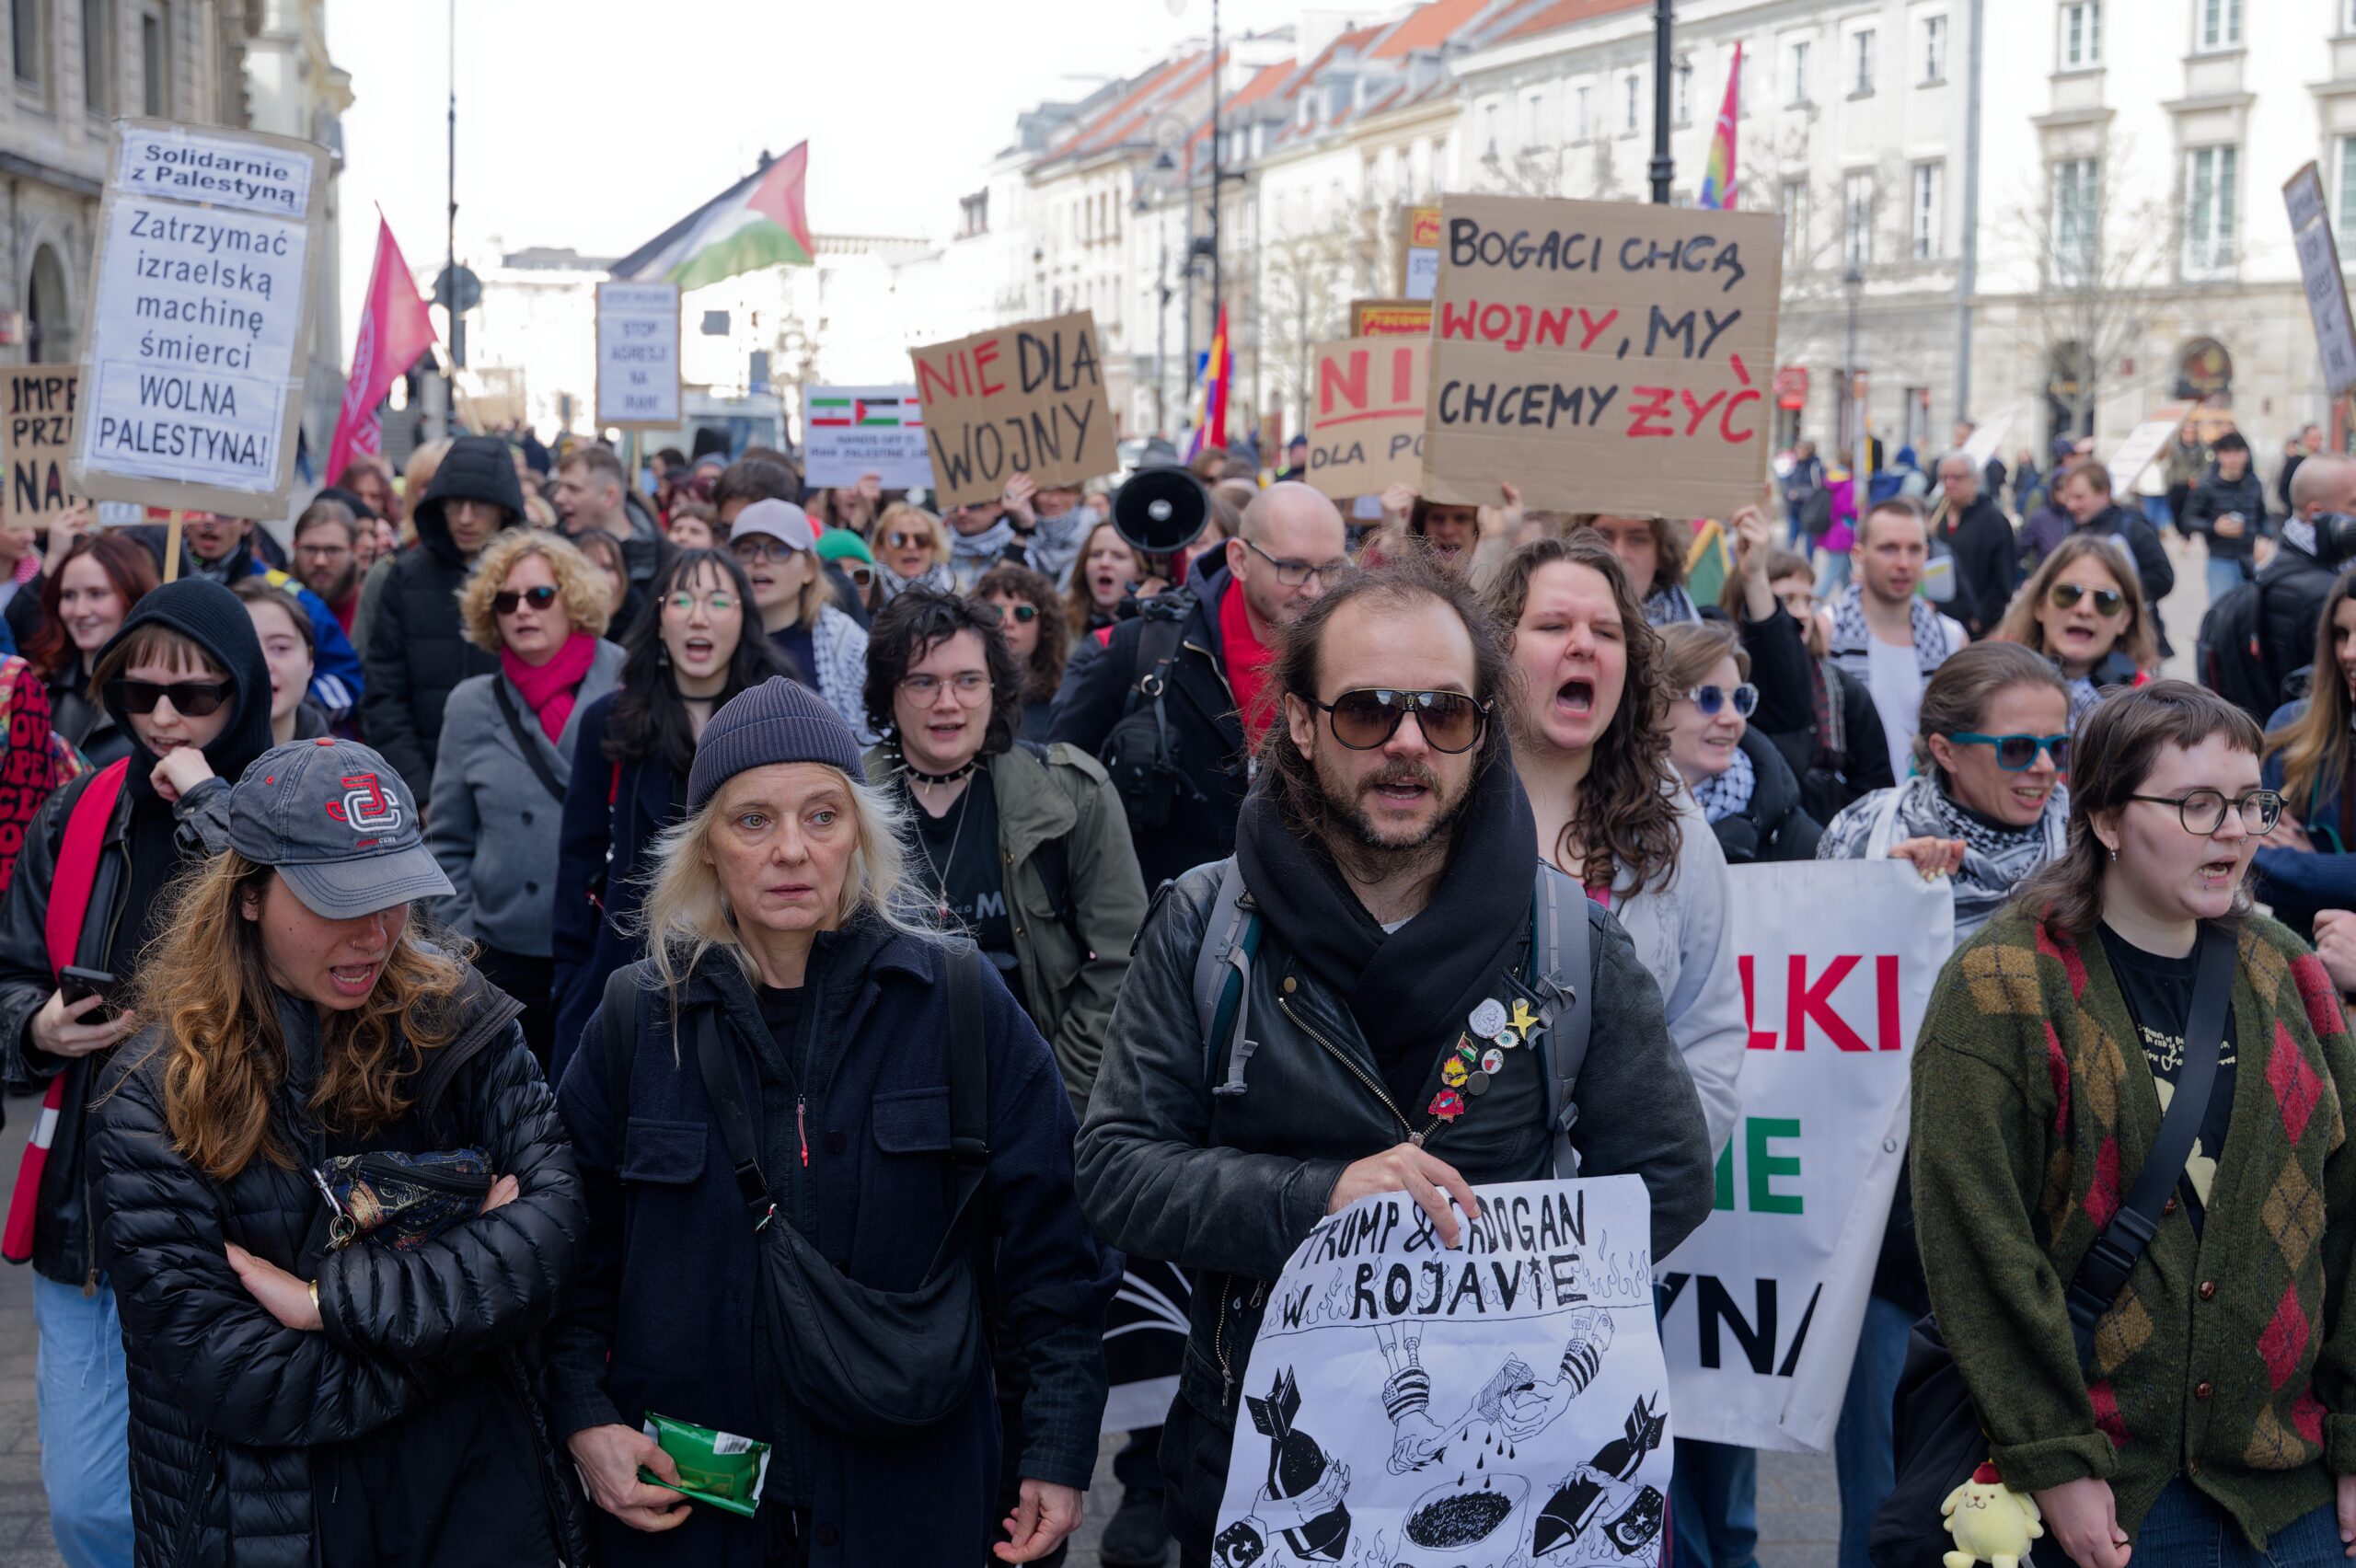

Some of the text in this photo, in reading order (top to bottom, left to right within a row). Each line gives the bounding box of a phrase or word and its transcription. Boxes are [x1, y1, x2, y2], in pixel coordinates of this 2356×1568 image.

[145, 144, 289, 181] Solidarnie
[132, 166, 296, 209] z Palestyną
[130, 210, 288, 257] Zatrzymać
[1449, 220, 1744, 292] BOGACI CHCĄ
[137, 249, 272, 302] izraelską
[136, 294, 264, 339] machinę
[1645, 306, 1741, 359] MY
[140, 330, 252, 370] śmierci
[918, 329, 1097, 404] NIE DLA
[140, 374, 237, 418] WOLNA
[1439, 381, 1618, 428] CHCEMY
[14, 417, 73, 447] PRZ
[98, 416, 268, 467] PALESTYNA!
[931, 398, 1093, 490] WOJNY
[1311, 442, 1365, 469] DLA
[1300, 1201, 1399, 1269] TRUMP
[1283, 1253, 1588, 1330] W ROJAVIE
